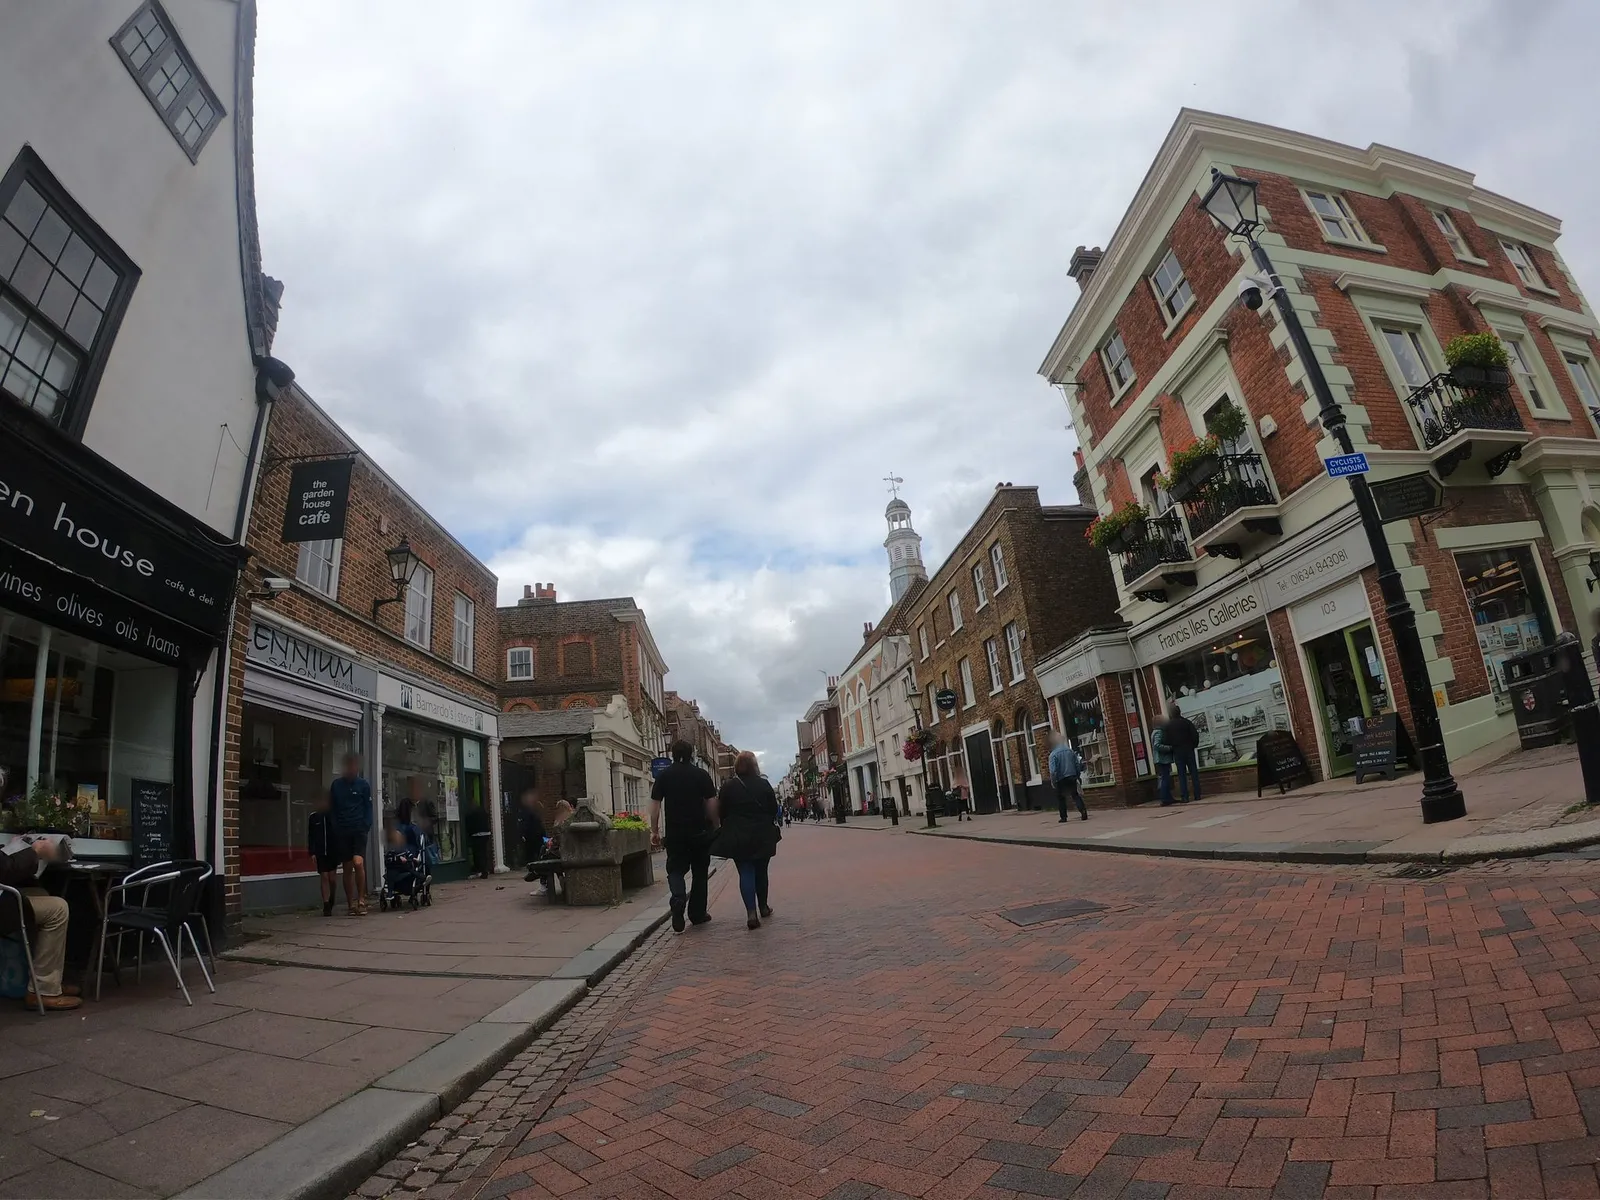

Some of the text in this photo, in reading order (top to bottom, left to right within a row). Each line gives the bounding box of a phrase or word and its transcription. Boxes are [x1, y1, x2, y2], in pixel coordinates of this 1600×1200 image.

[1330, 456, 1362, 467] CYCLISTS
[1330, 463, 1366, 475] DISMOUNT
[312, 480, 328, 489] the
[302, 489, 335, 501] garden
[302, 500, 331, 509] house
[53, 502, 155, 576] house
[1290, 566, 1315, 585] 01634
[1315, 548, 1349, 573] 843081
[188, 588, 196, 597] &
[198, 594, 214, 606] deli
[1320, 601, 1337, 616] 103
[56, 593, 104, 627] olives
[116, 617, 139, 641] oils
[146, 627, 180, 658] hams
[1157, 626, 1191, 650] Francis
[1188, 618, 1209, 637] Iles
[1208, 595, 1257, 627] Galleries
[254, 623, 354, 684] ENNIUM
[267, 657, 317, 680] SALON
[416, 693, 474, 726] Barnardo's store
